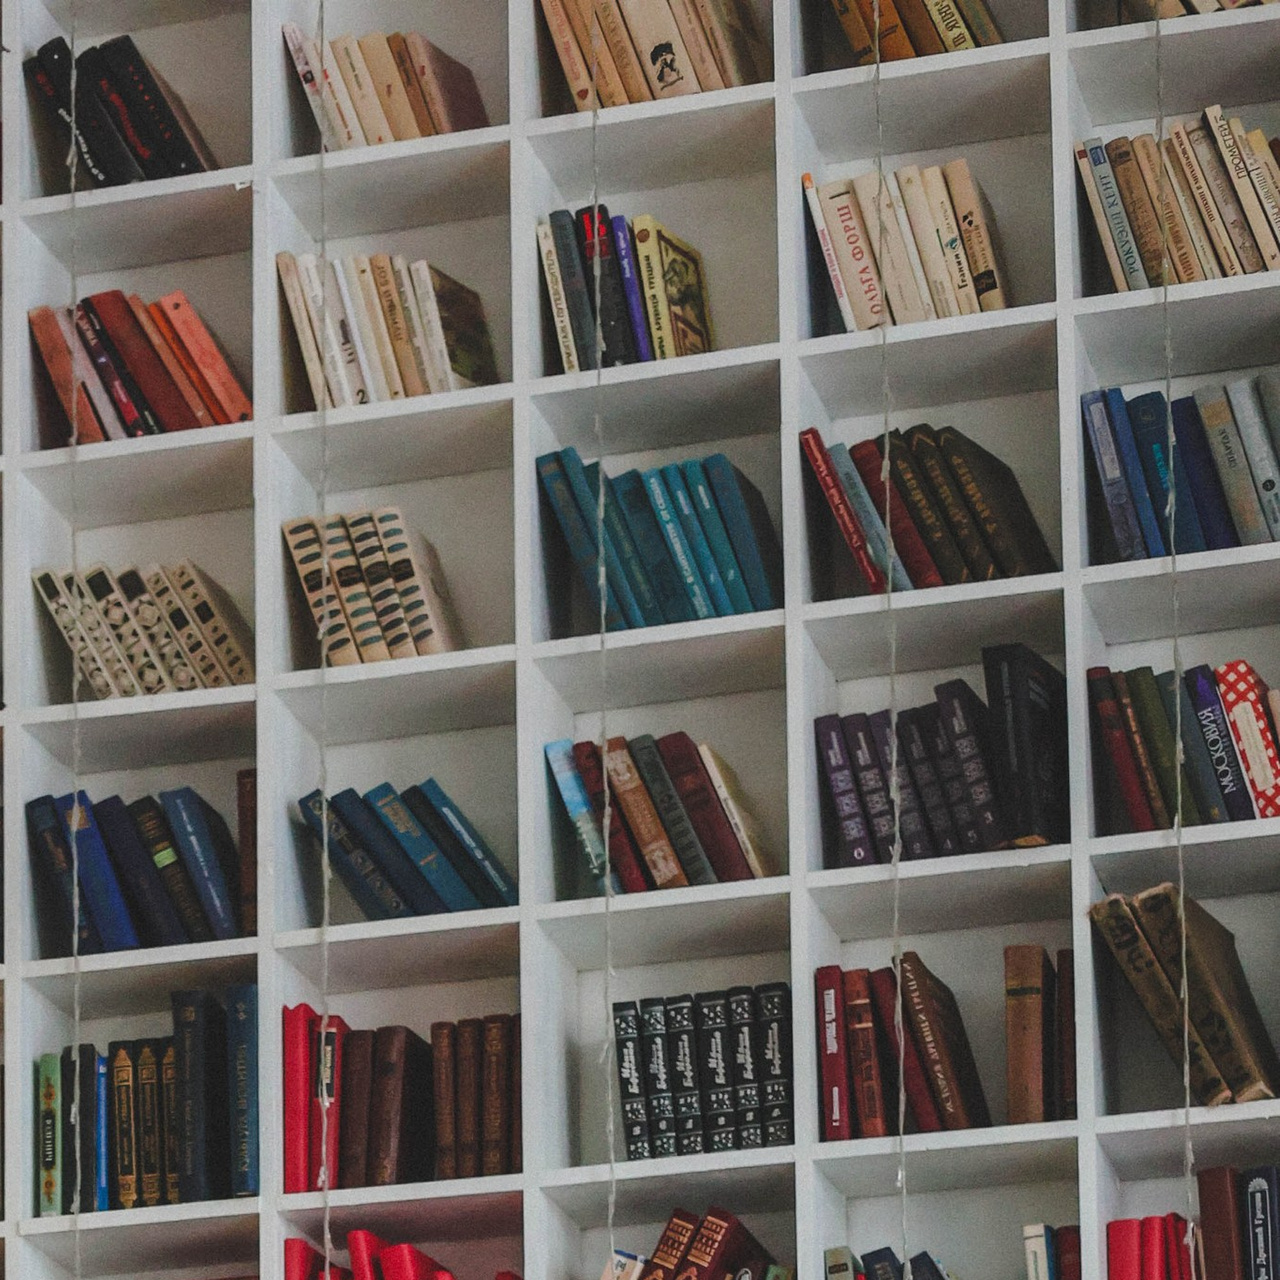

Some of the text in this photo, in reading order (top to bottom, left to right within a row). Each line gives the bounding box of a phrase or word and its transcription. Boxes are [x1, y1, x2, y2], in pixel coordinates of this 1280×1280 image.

[1216, 122, 1248, 180] ПРОМЕТЕЙ
[1097, 172, 1119, 209] КЕНТ
[836, 202, 883, 316] ОЛЬГА ФОРШ
[1195, 706, 1239, 794] МОСКОВИЯ
